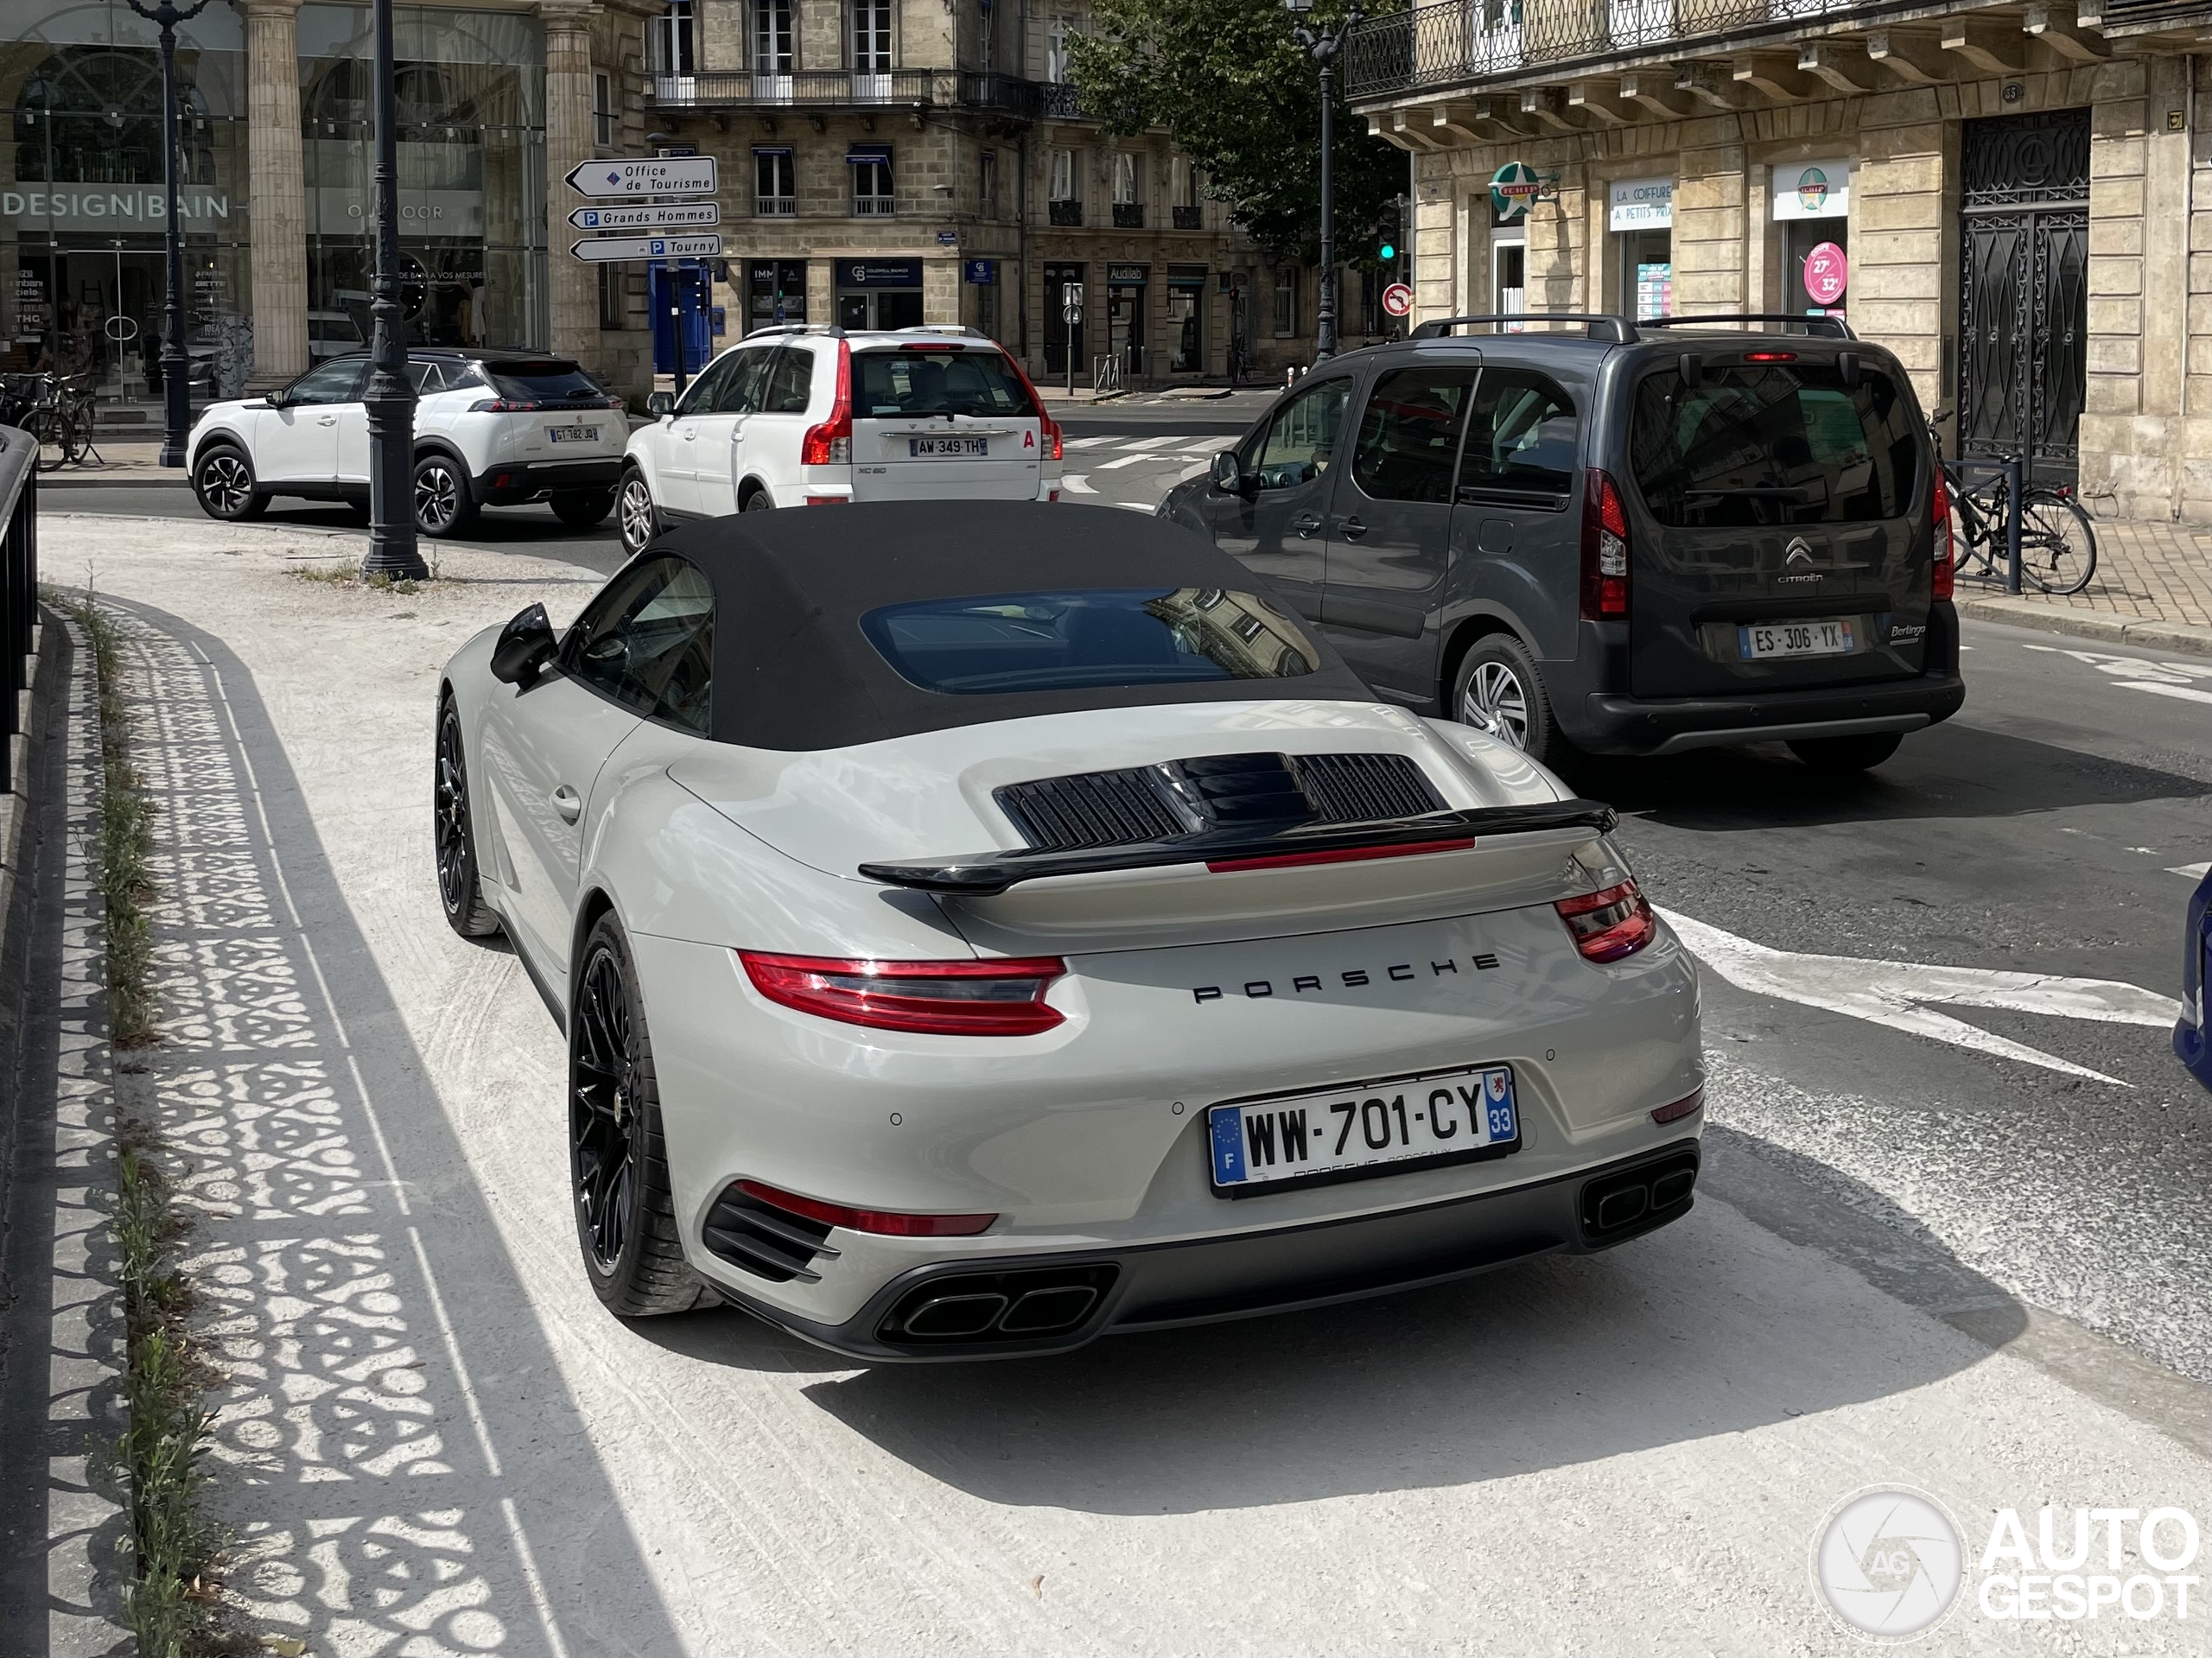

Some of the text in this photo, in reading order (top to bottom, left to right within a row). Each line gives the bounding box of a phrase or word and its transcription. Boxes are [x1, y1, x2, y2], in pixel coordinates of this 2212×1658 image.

[2004, 88, 2016, 98] 35
[626, 165, 667, 177] Office
[626, 178, 710, 190] de Tourisme
[1503, 186, 1538, 194] TCHIP
[1617, 186, 1672, 202] LA COIFFURE
[586, 210, 713, 226] P Grands Hommes
[1615, 204, 1672, 220] A PETITS PRIX
[652, 241, 715, 254] P Tourny
[1110, 267, 1141, 280] Audilab
[1023, 430, 1035, 448] A
[919, 440, 980, 454] AW-349-TH
[1778, 573, 1823, 584] CITROËN
[1891, 624, 1926, 637] Berlingo
[1755, 625, 1839, 652] ES-306-YX
[1192, 953, 1500, 1004] PORSCHE
[1224, 1153, 1234, 1169] F
[1245, 1083, 1482, 1168] WW-701-CY
[1489, 1107, 1512, 1134] 33
